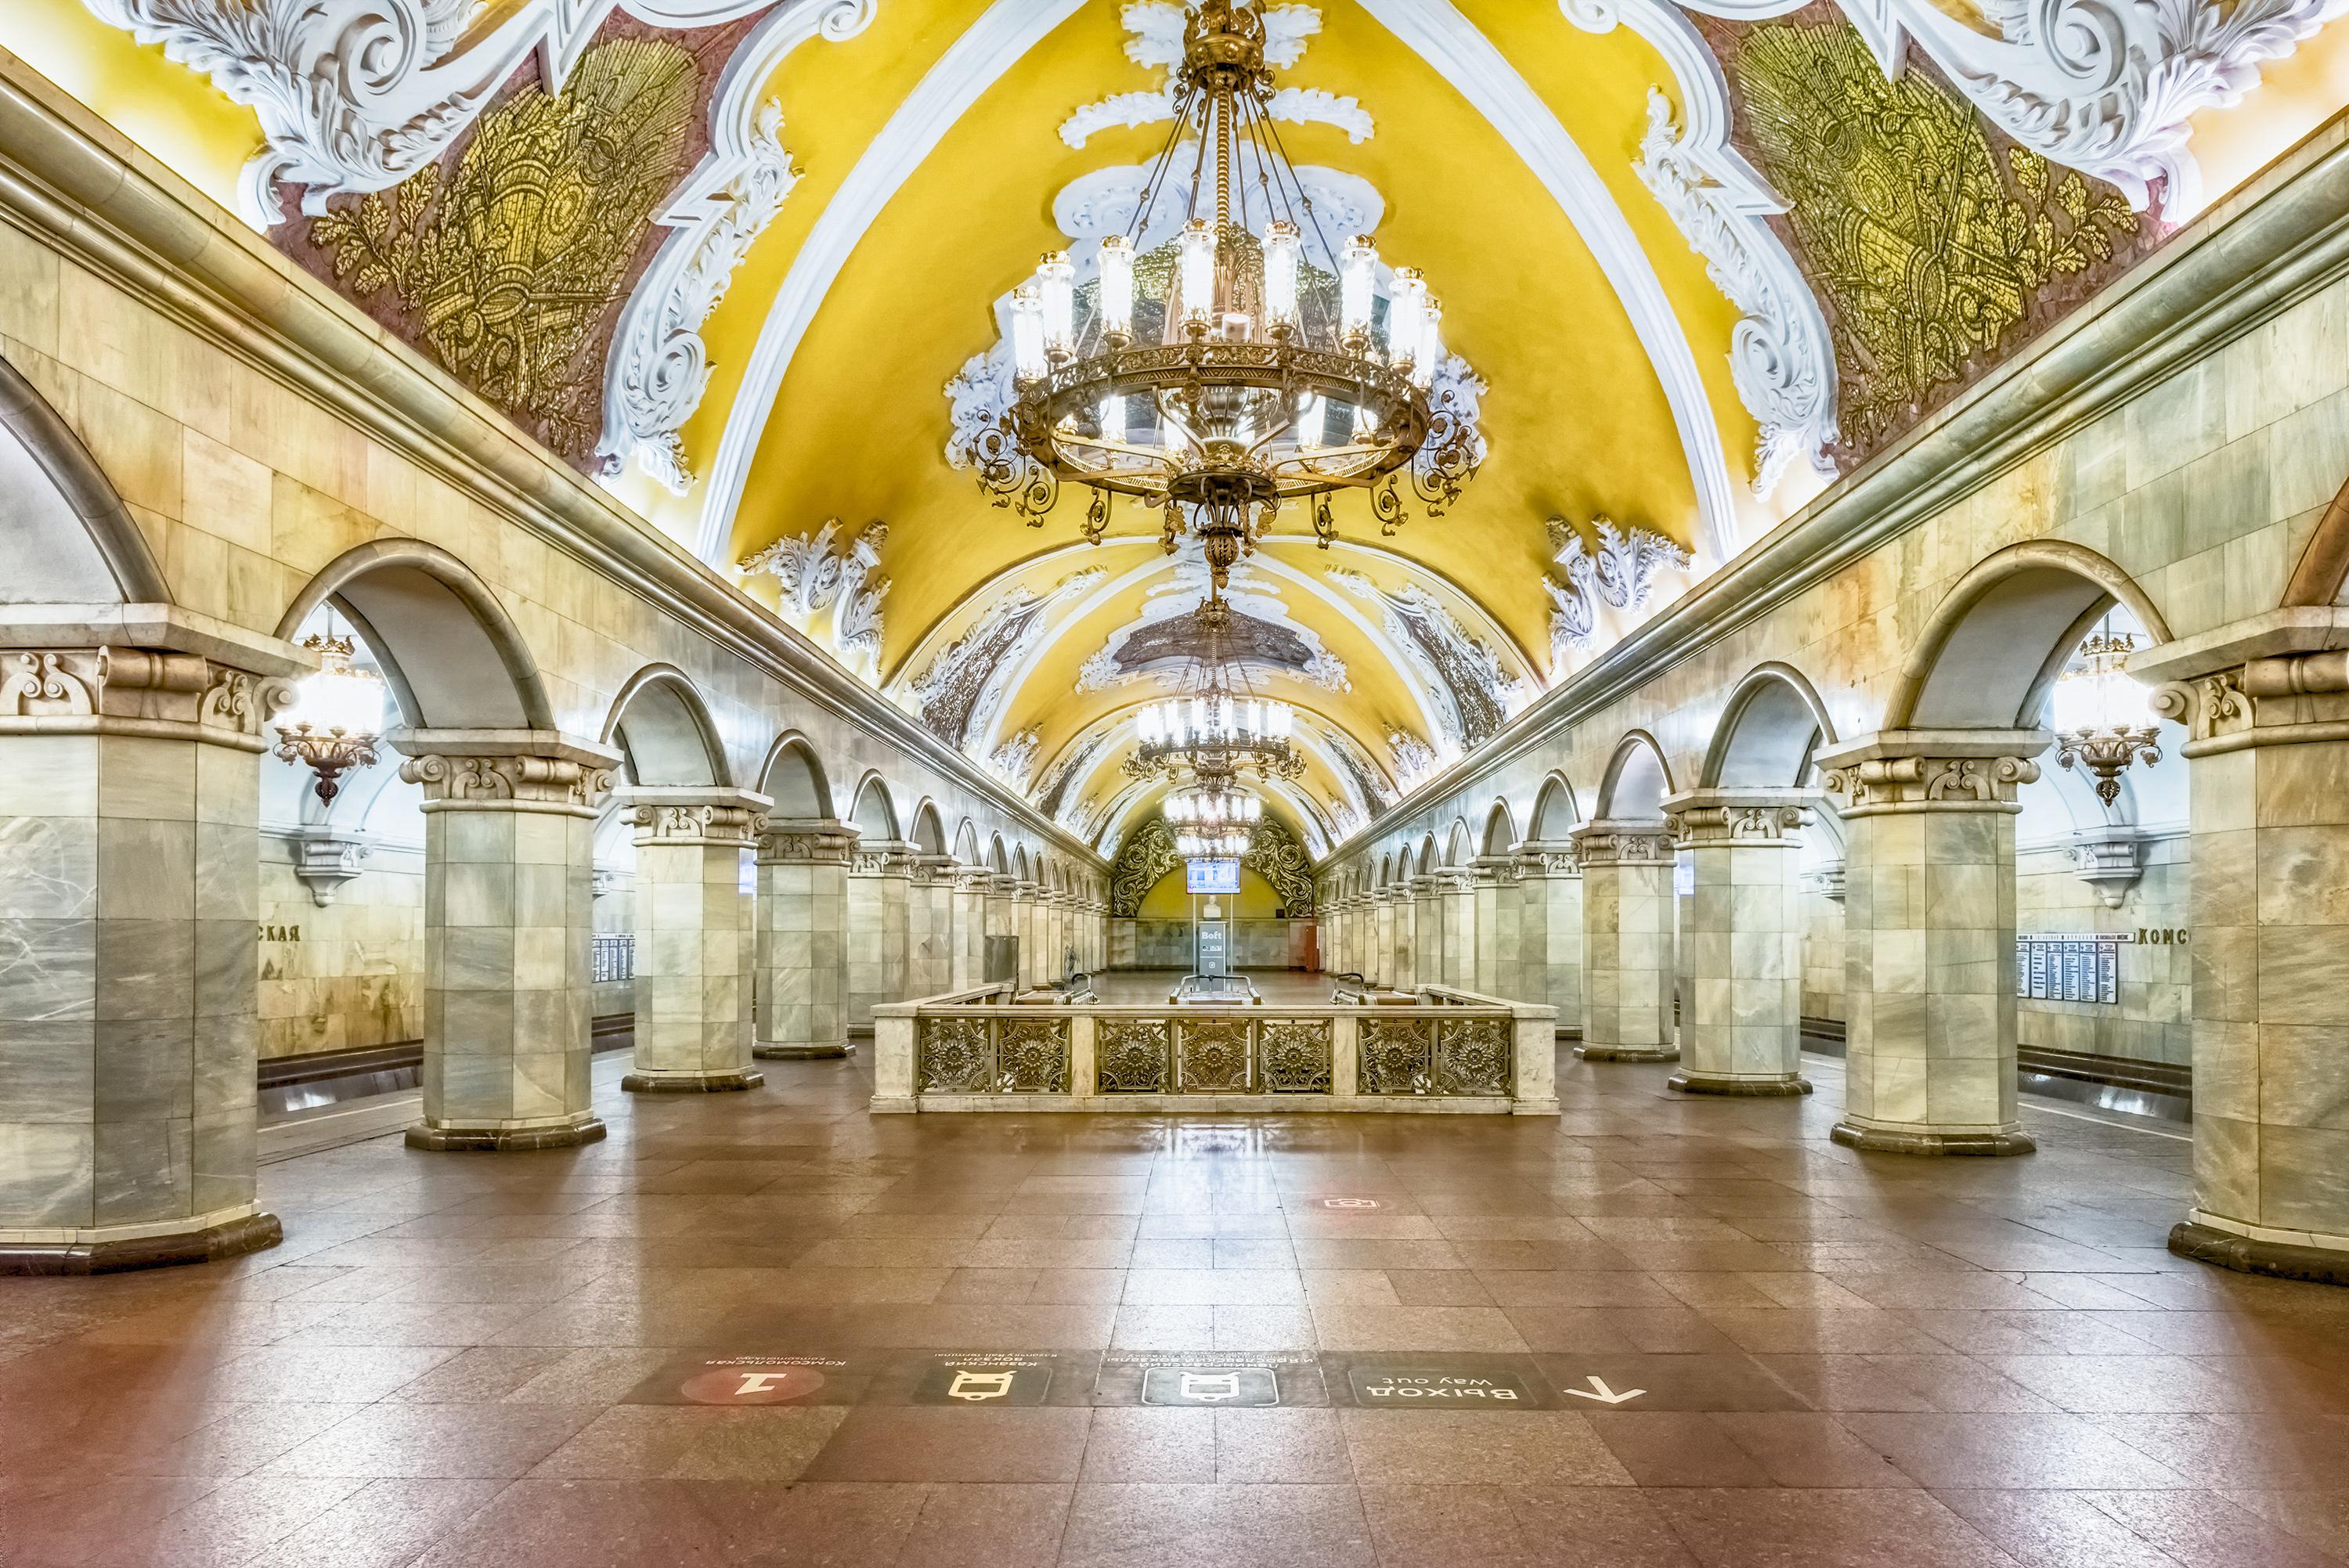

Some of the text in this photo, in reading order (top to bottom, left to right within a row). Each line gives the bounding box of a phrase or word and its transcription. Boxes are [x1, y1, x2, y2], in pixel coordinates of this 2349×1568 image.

[1201, 931, 1221, 939] Boft
[2138, 928, 2192, 945] КОМС
[734, 1372, 787, 1396] 1
[1439, 1376, 1493, 1386] Way
[1366, 1386, 1519, 1400] Выход
